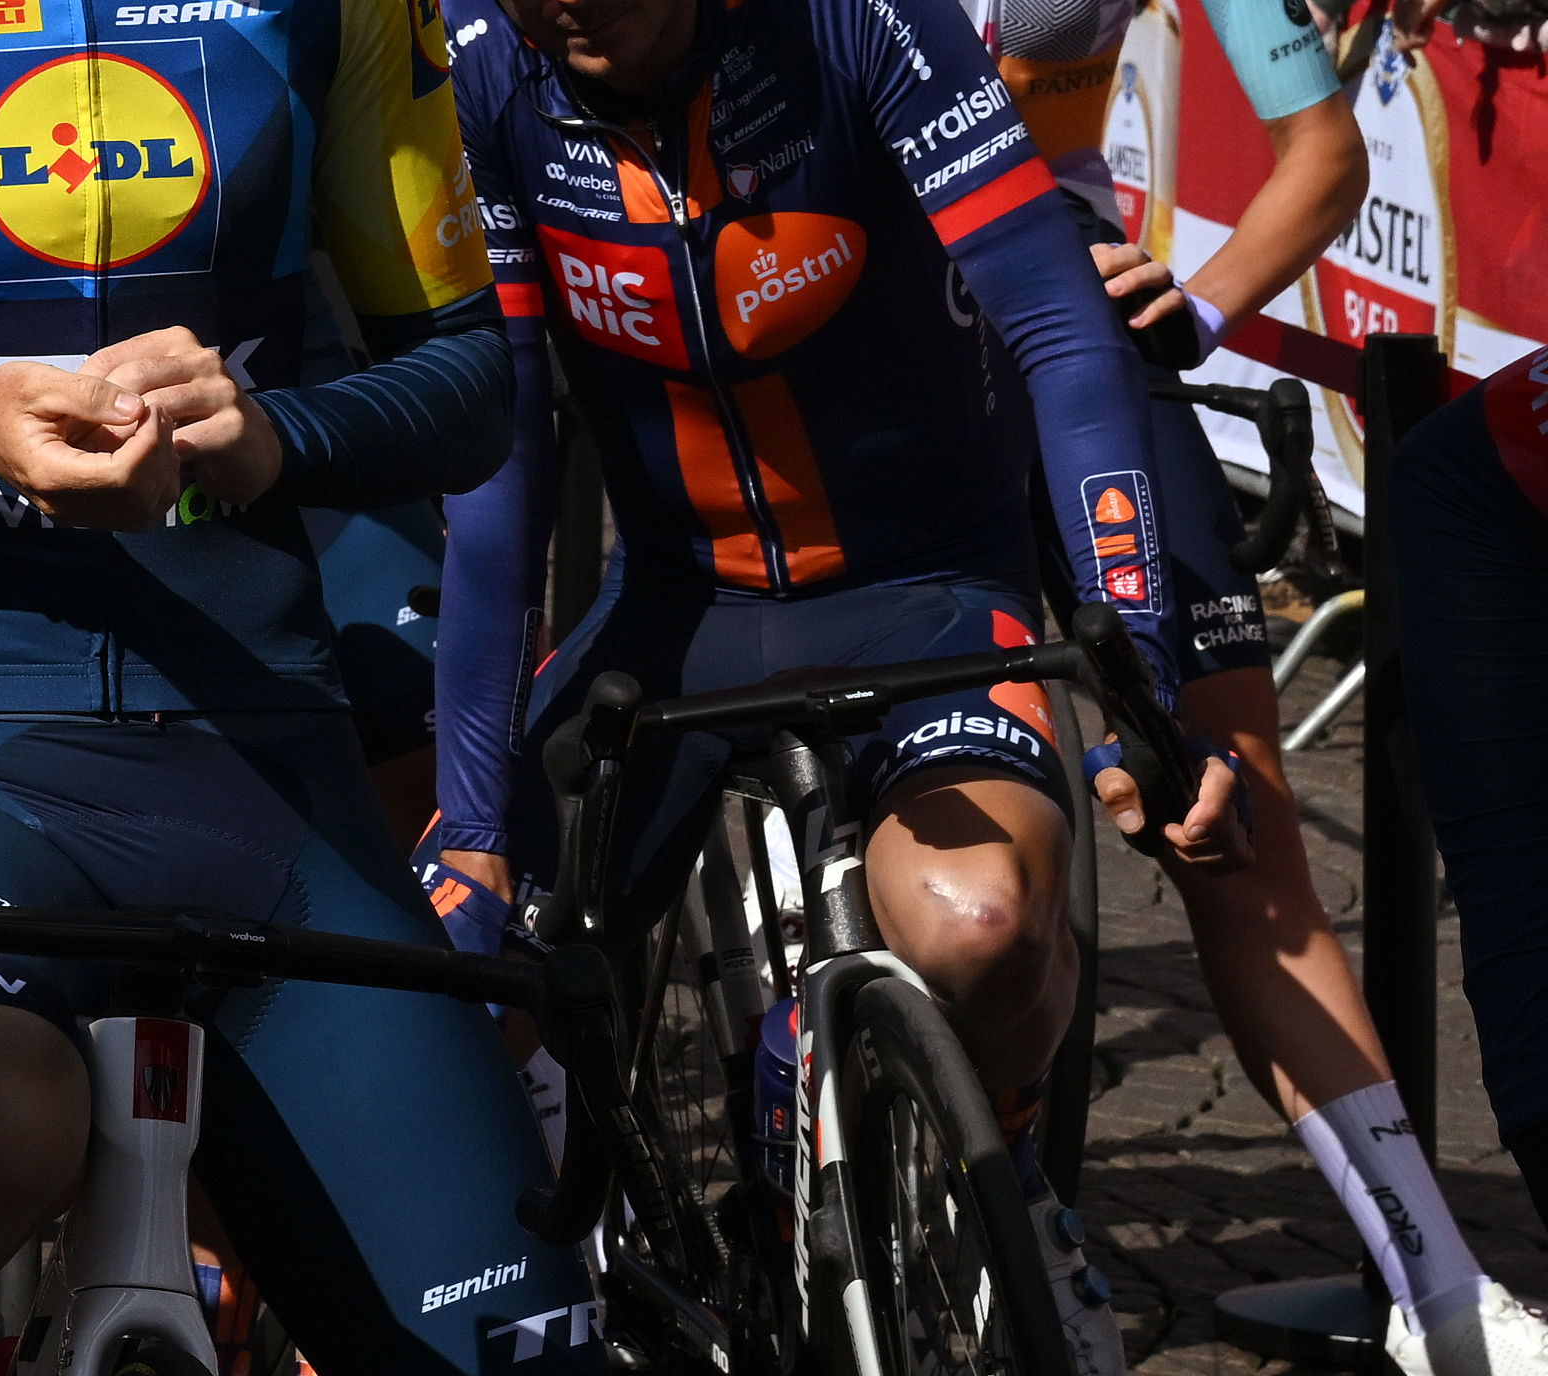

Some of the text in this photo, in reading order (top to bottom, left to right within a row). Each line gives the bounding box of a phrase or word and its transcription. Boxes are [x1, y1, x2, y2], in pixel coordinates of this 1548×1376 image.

[732, 99, 788, 142] MICHELIN
[921, 75, 1011, 149] raisin
[757, 128, 816, 180] Nalini
[912, 121, 1030, 198] LAPIERRE
[734, 233, 855, 325] postnl
[895, 709, 1043, 759] raisin
[229, 931, 266, 944] wahoo
[422, 1257, 527, 1314] Santini
